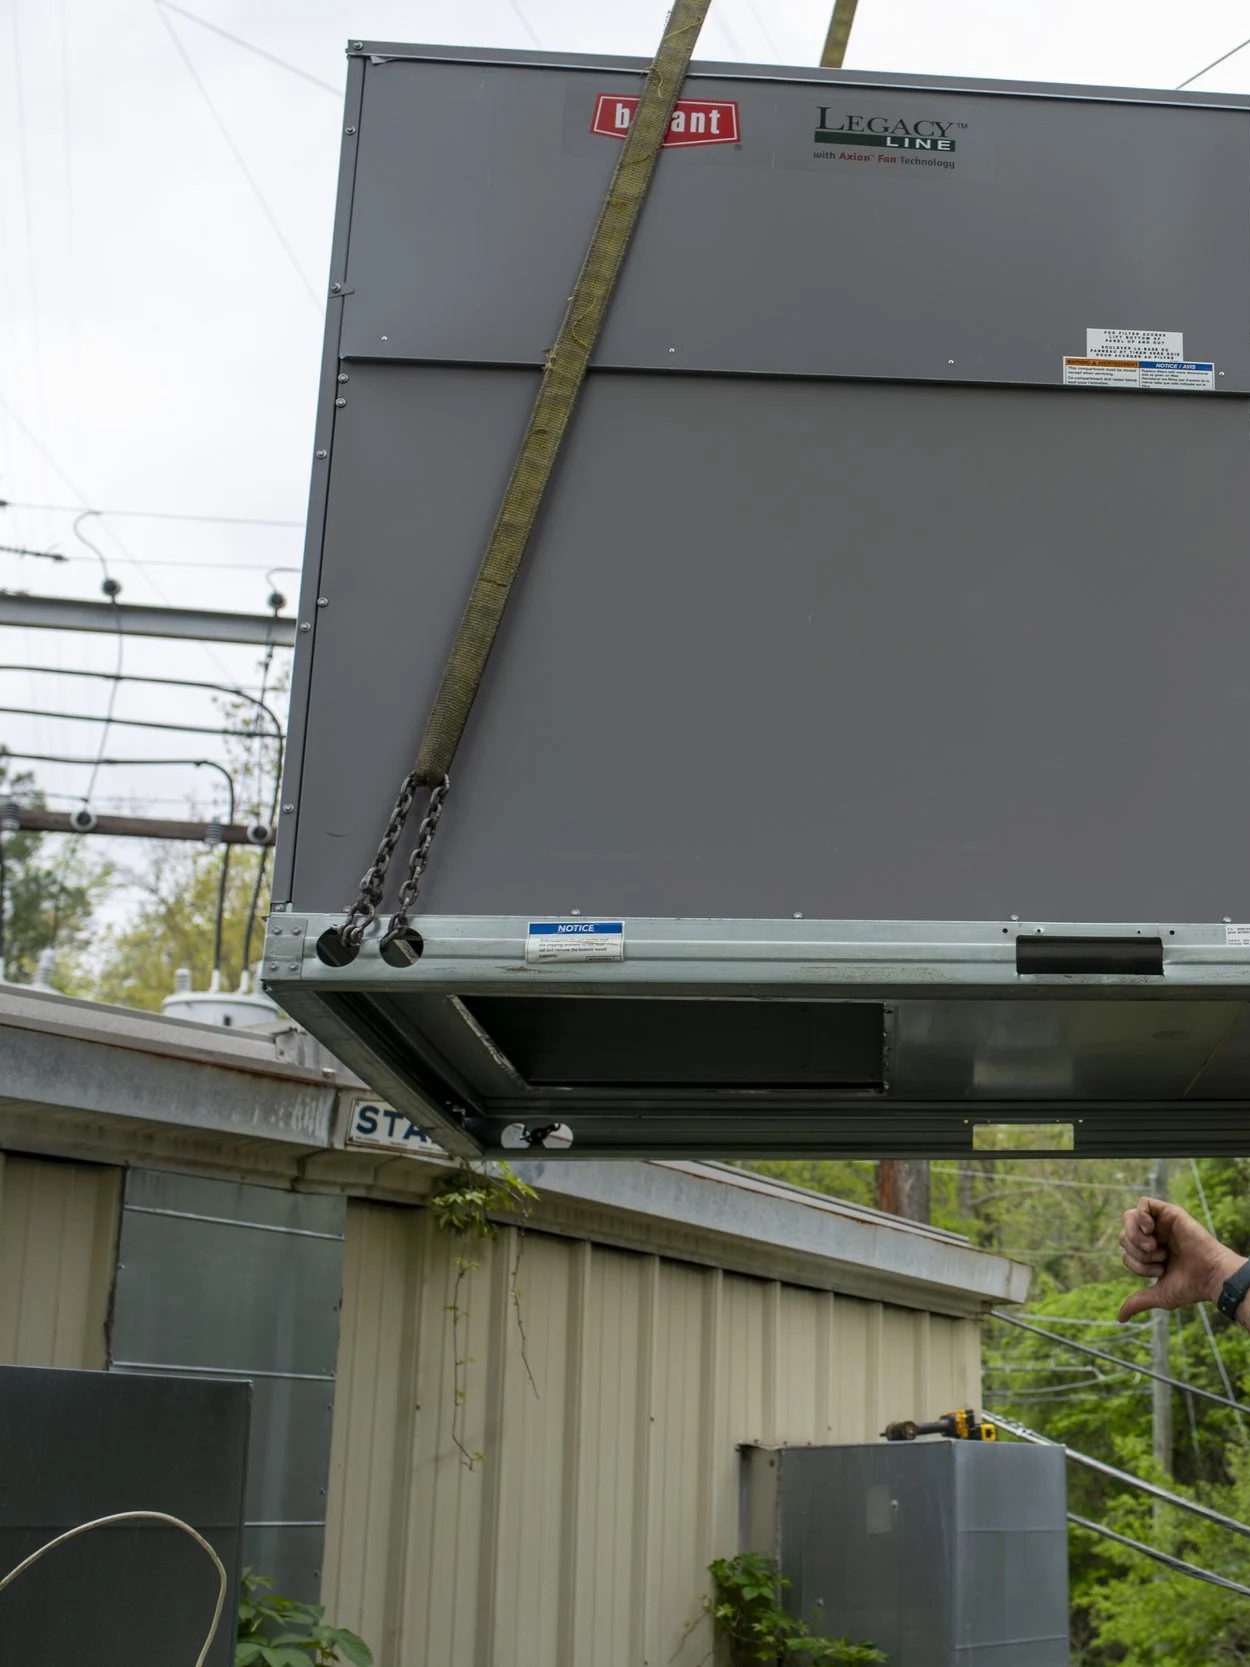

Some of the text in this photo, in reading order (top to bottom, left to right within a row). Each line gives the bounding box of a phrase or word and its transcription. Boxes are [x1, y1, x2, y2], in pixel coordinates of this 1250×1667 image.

[614, 103, 721, 135] bant
[815, 106, 954, 137] LEGACY
[885, 136, 952, 151] LINE
[813, 151, 956, 170] with Axion Fan Technology
